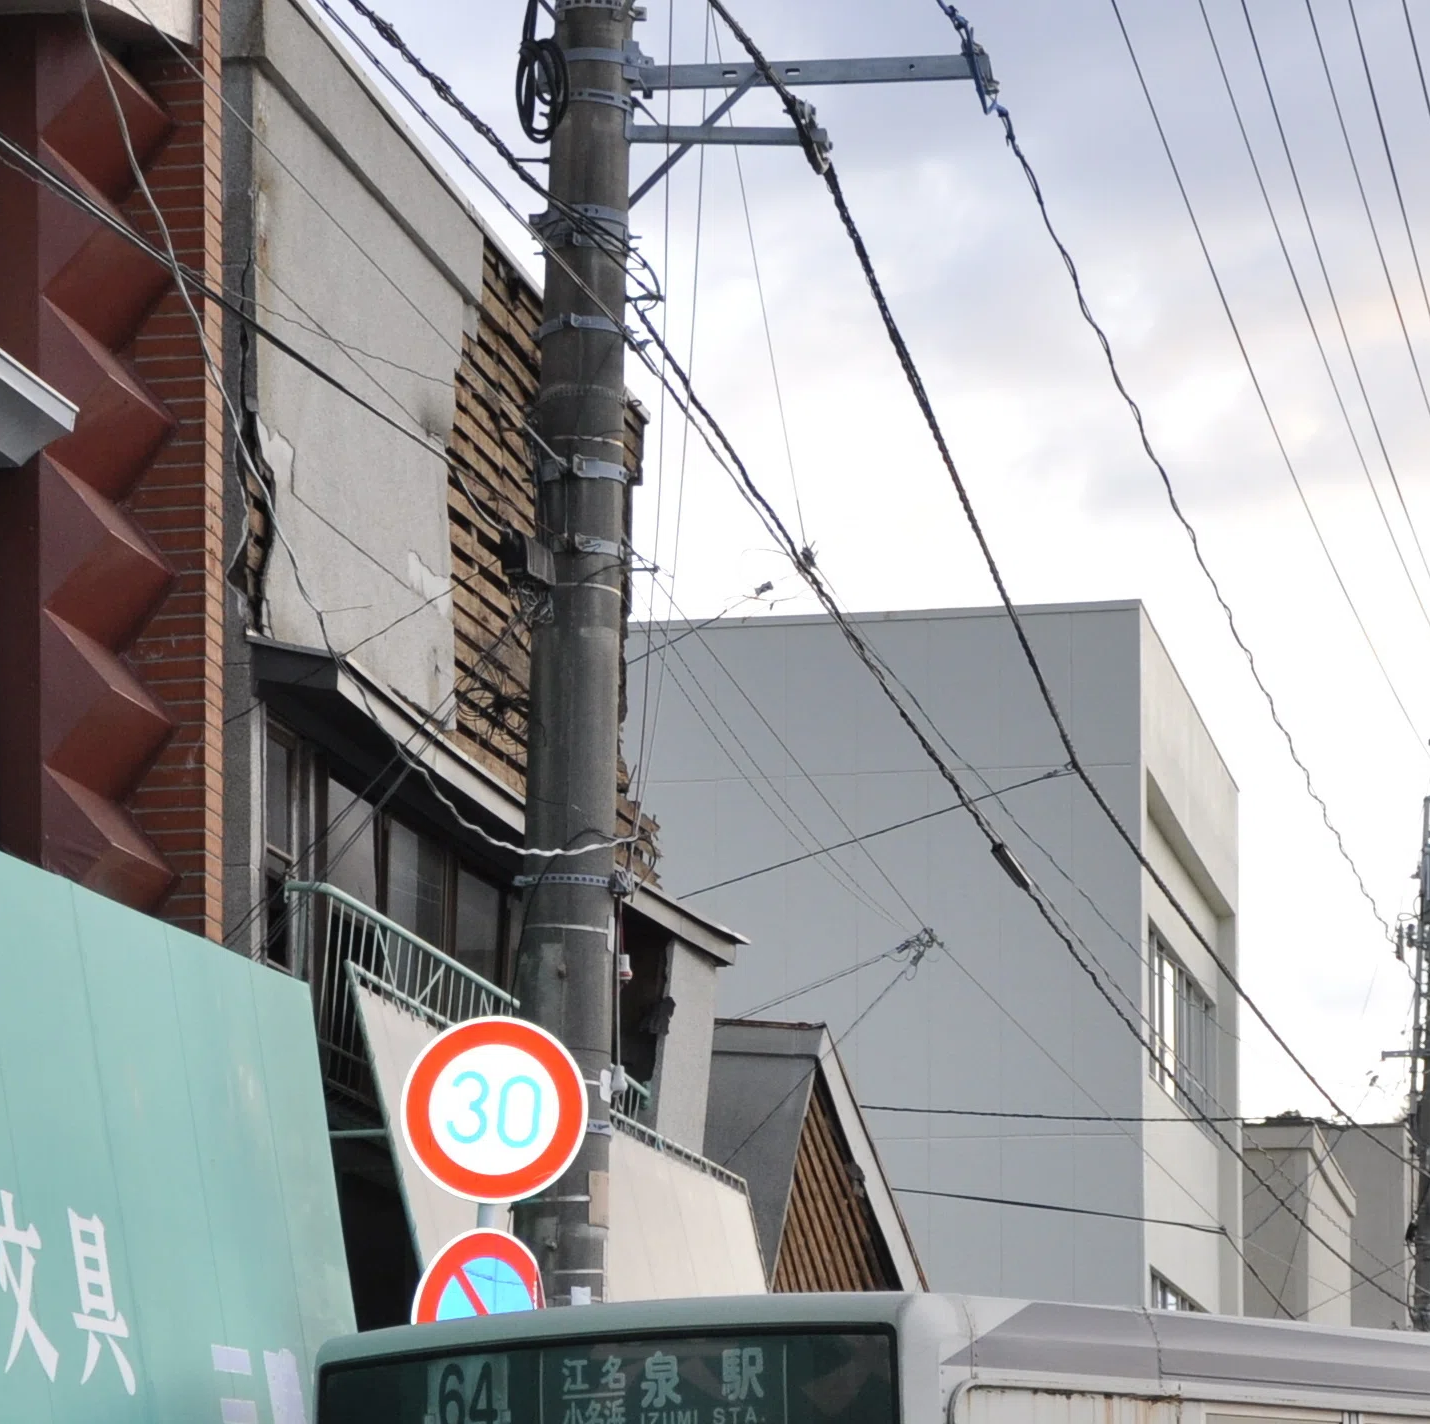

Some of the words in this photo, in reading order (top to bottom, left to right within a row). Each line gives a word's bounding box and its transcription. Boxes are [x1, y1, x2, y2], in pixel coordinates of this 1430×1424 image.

[446, 1070, 542, 1149] 30
[562, 1355, 626, 1392] 江名
[641, 1346, 765, 1409] 泉駅
